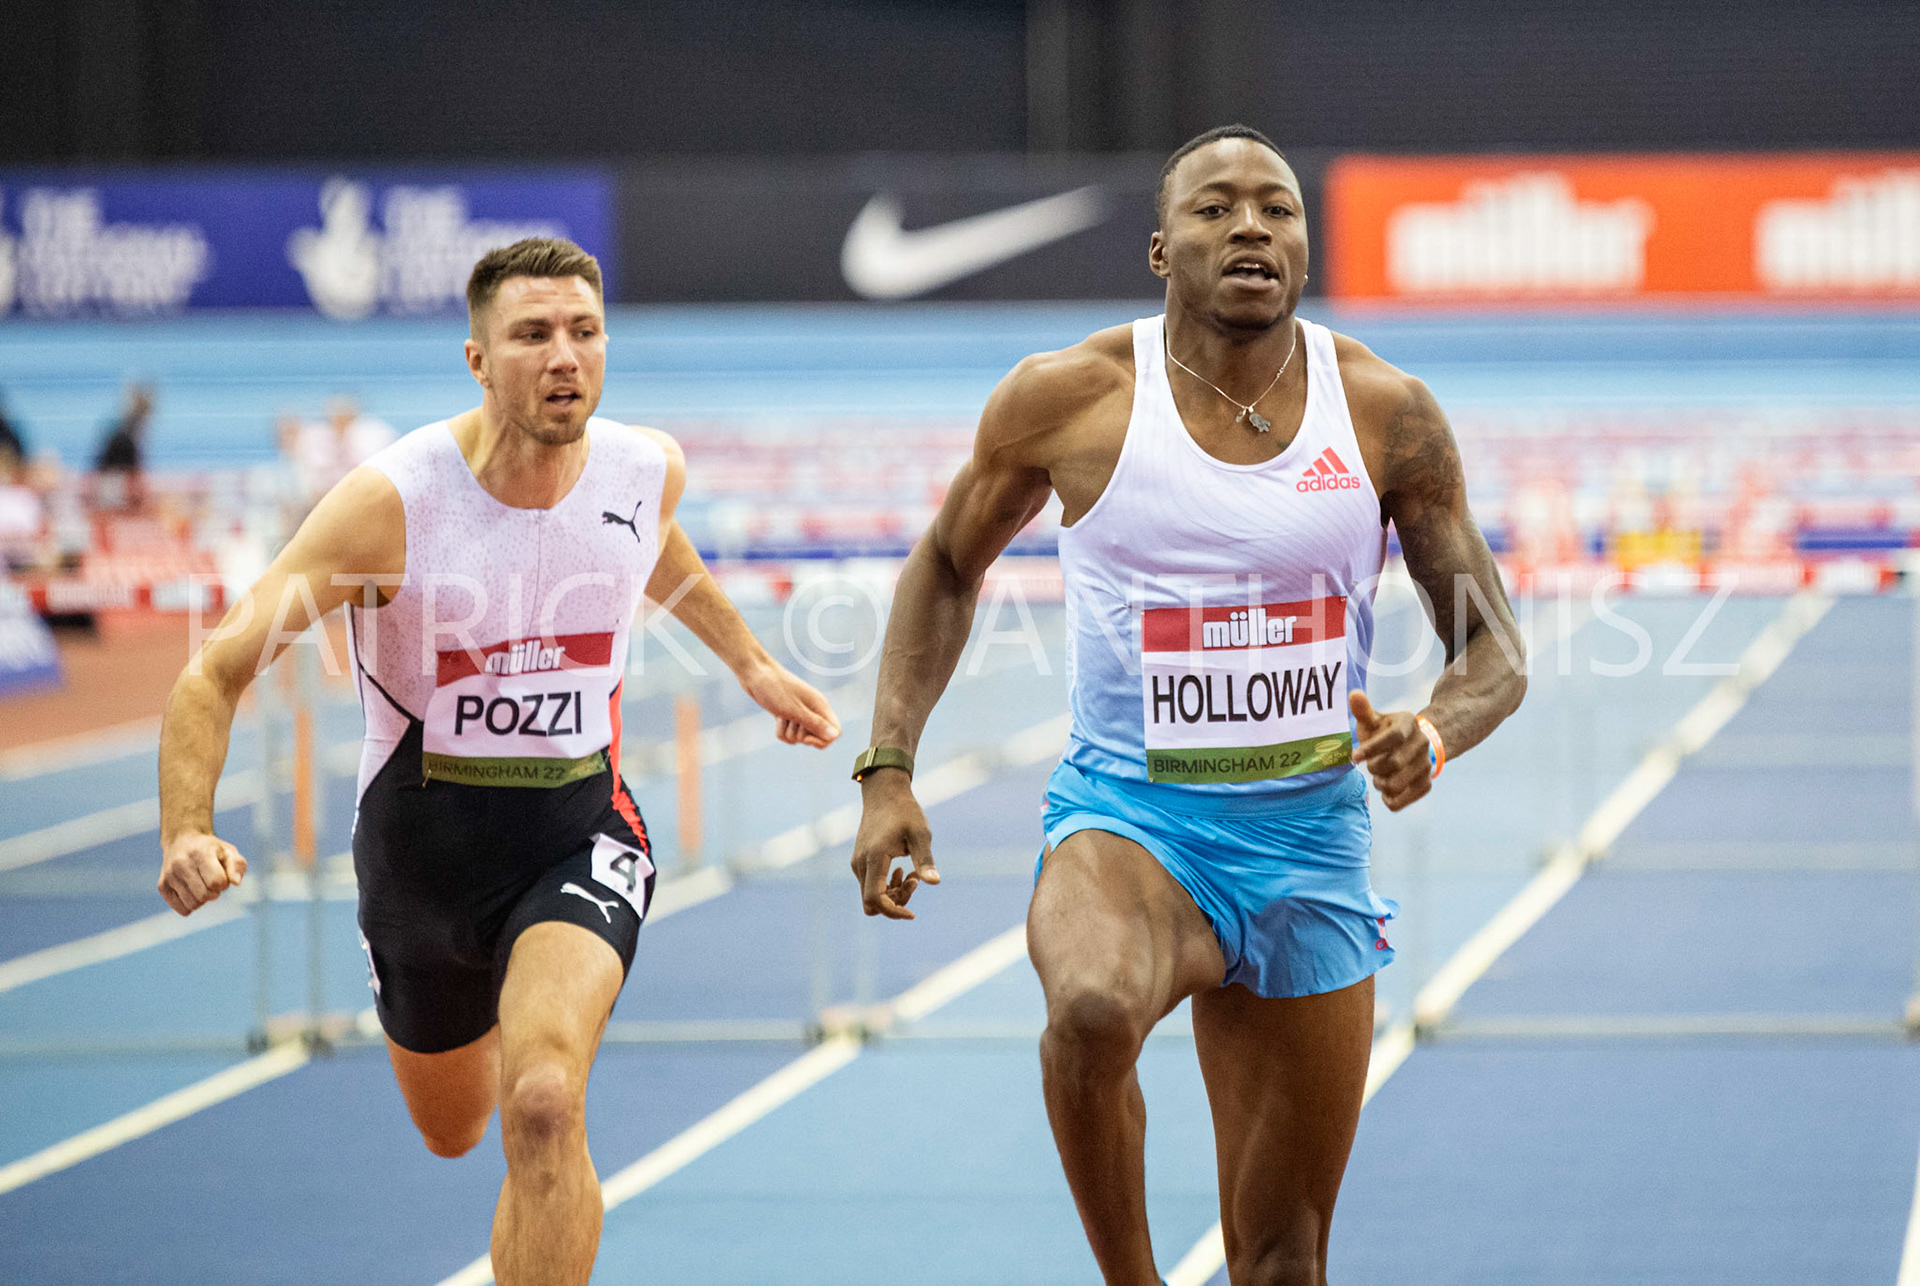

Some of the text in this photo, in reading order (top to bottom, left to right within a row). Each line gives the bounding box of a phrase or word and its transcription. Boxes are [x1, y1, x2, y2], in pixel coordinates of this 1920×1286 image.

[1296, 474, 1361, 493] adidas
[1202, 607, 1298, 648] müller
[484, 639, 566, 675] müller
[1151, 661, 1342, 724] HOLLOWAY
[454, 690, 582, 737] POZZI
[427, 760, 566, 780] BIRMINGHAM 22
[1153, 751, 1301, 774] BIRMINGHAM 22
[610, 851, 640, 894] 4
